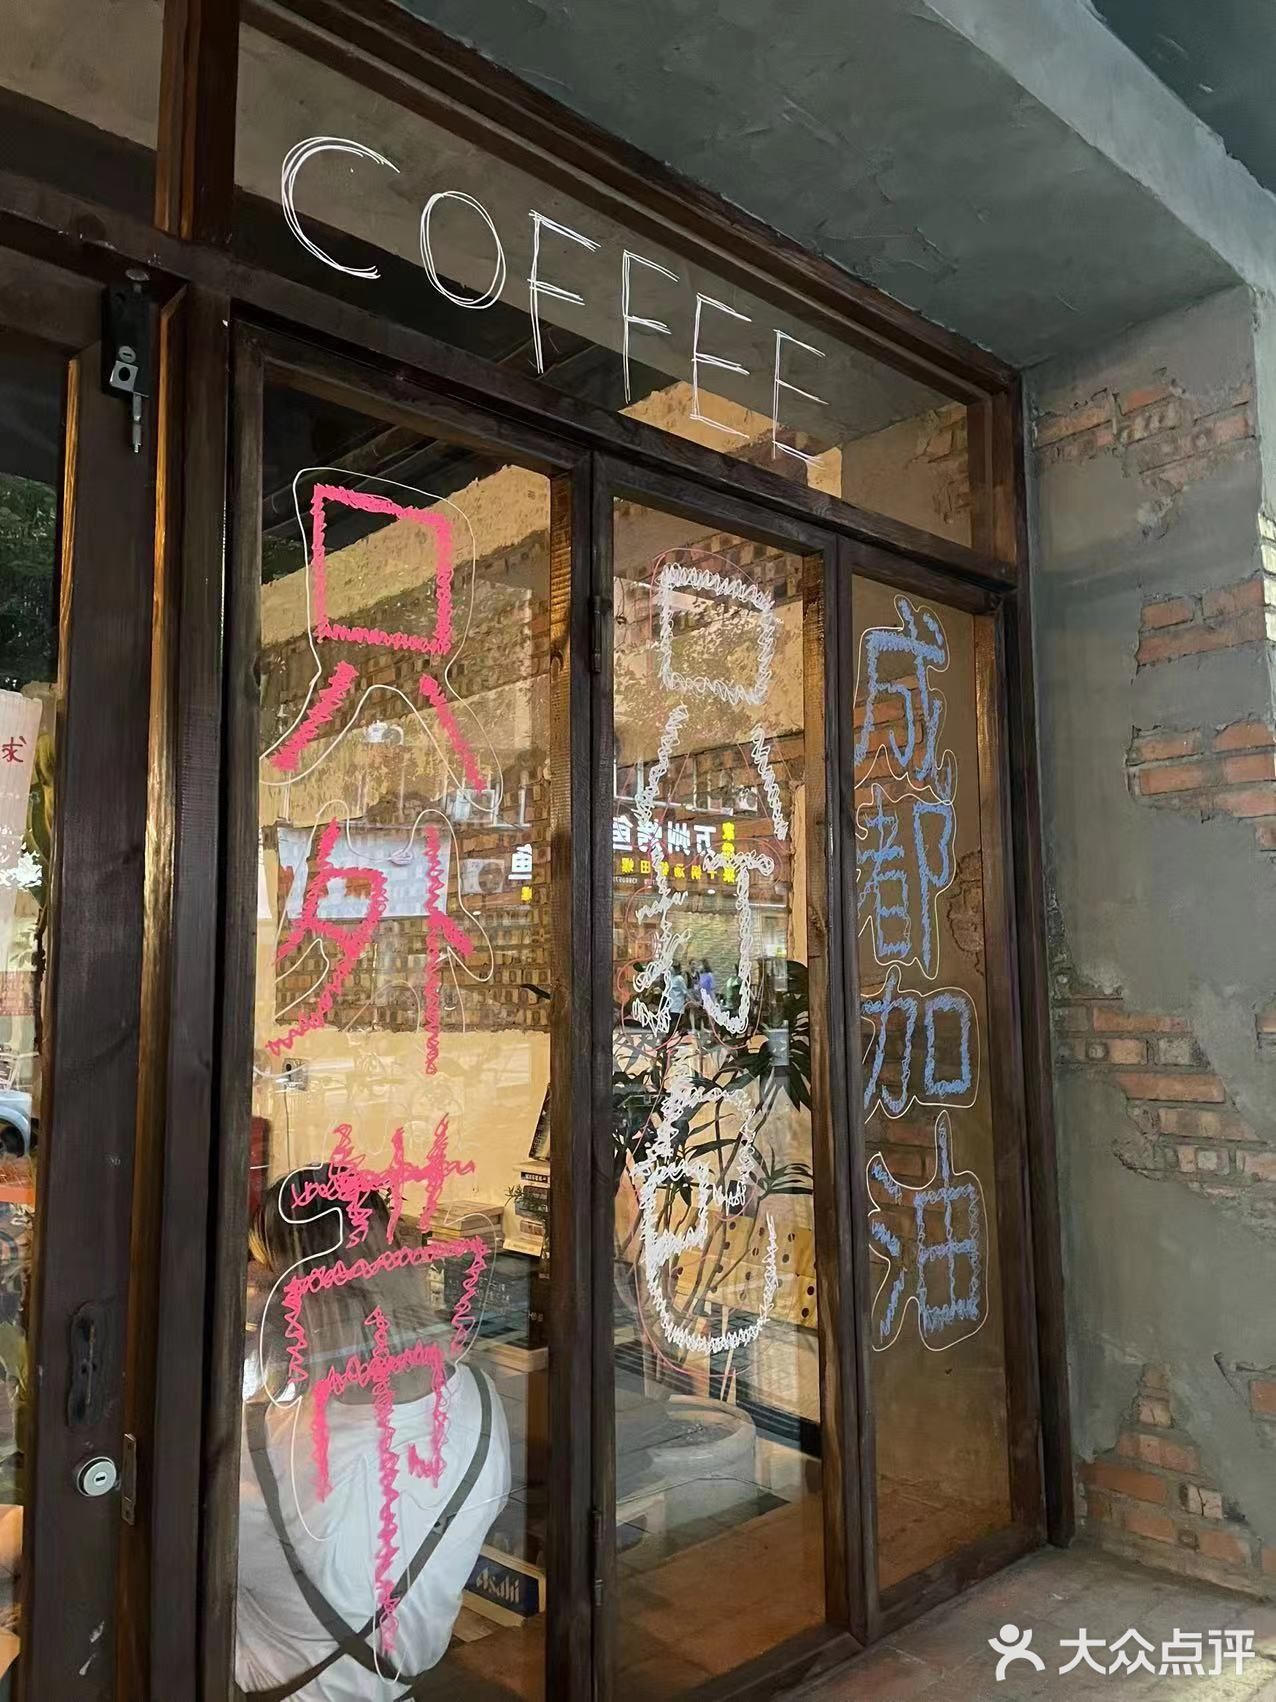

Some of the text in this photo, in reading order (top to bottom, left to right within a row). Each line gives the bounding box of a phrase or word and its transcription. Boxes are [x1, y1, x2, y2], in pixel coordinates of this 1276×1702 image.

[281, 136, 829, 470] COFFEE
[2, 735, 27, 763] 求
[632, 562, 790, 1351] 只打包
[854, 597, 981, 1338] 成都加油
[477, 1567, 520, 1603] Asahi
